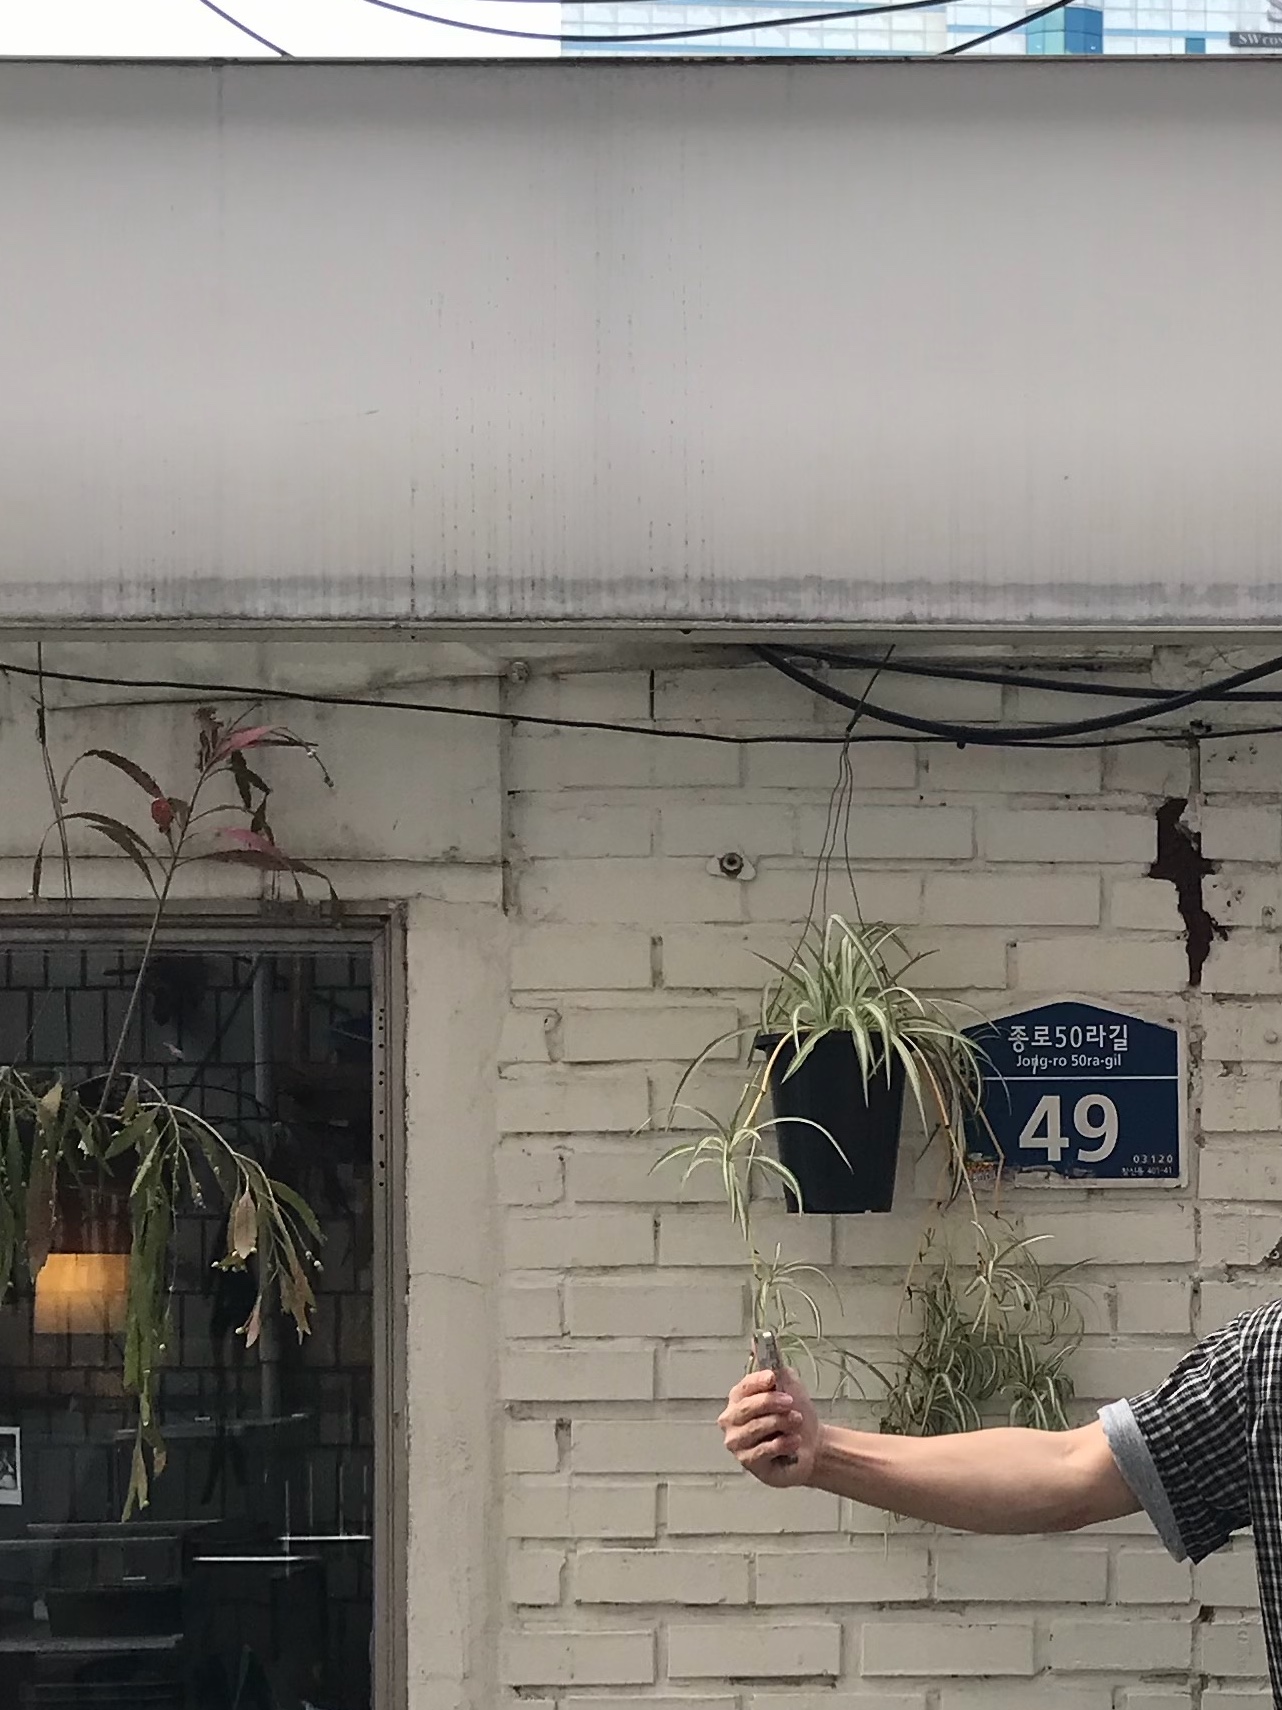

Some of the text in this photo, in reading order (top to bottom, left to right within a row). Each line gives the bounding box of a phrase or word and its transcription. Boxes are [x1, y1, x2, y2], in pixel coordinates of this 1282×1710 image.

[1239, 33, 1260, 45] SW
[1008, 1024, 1129, 1052] 종로50라길
[1016, 1053, 1122, 1070] Jong-ro 50ra-gil
[1019, 1093, 1119, 1163] 49
[1133, 1154, 1173, 1164] 03120
